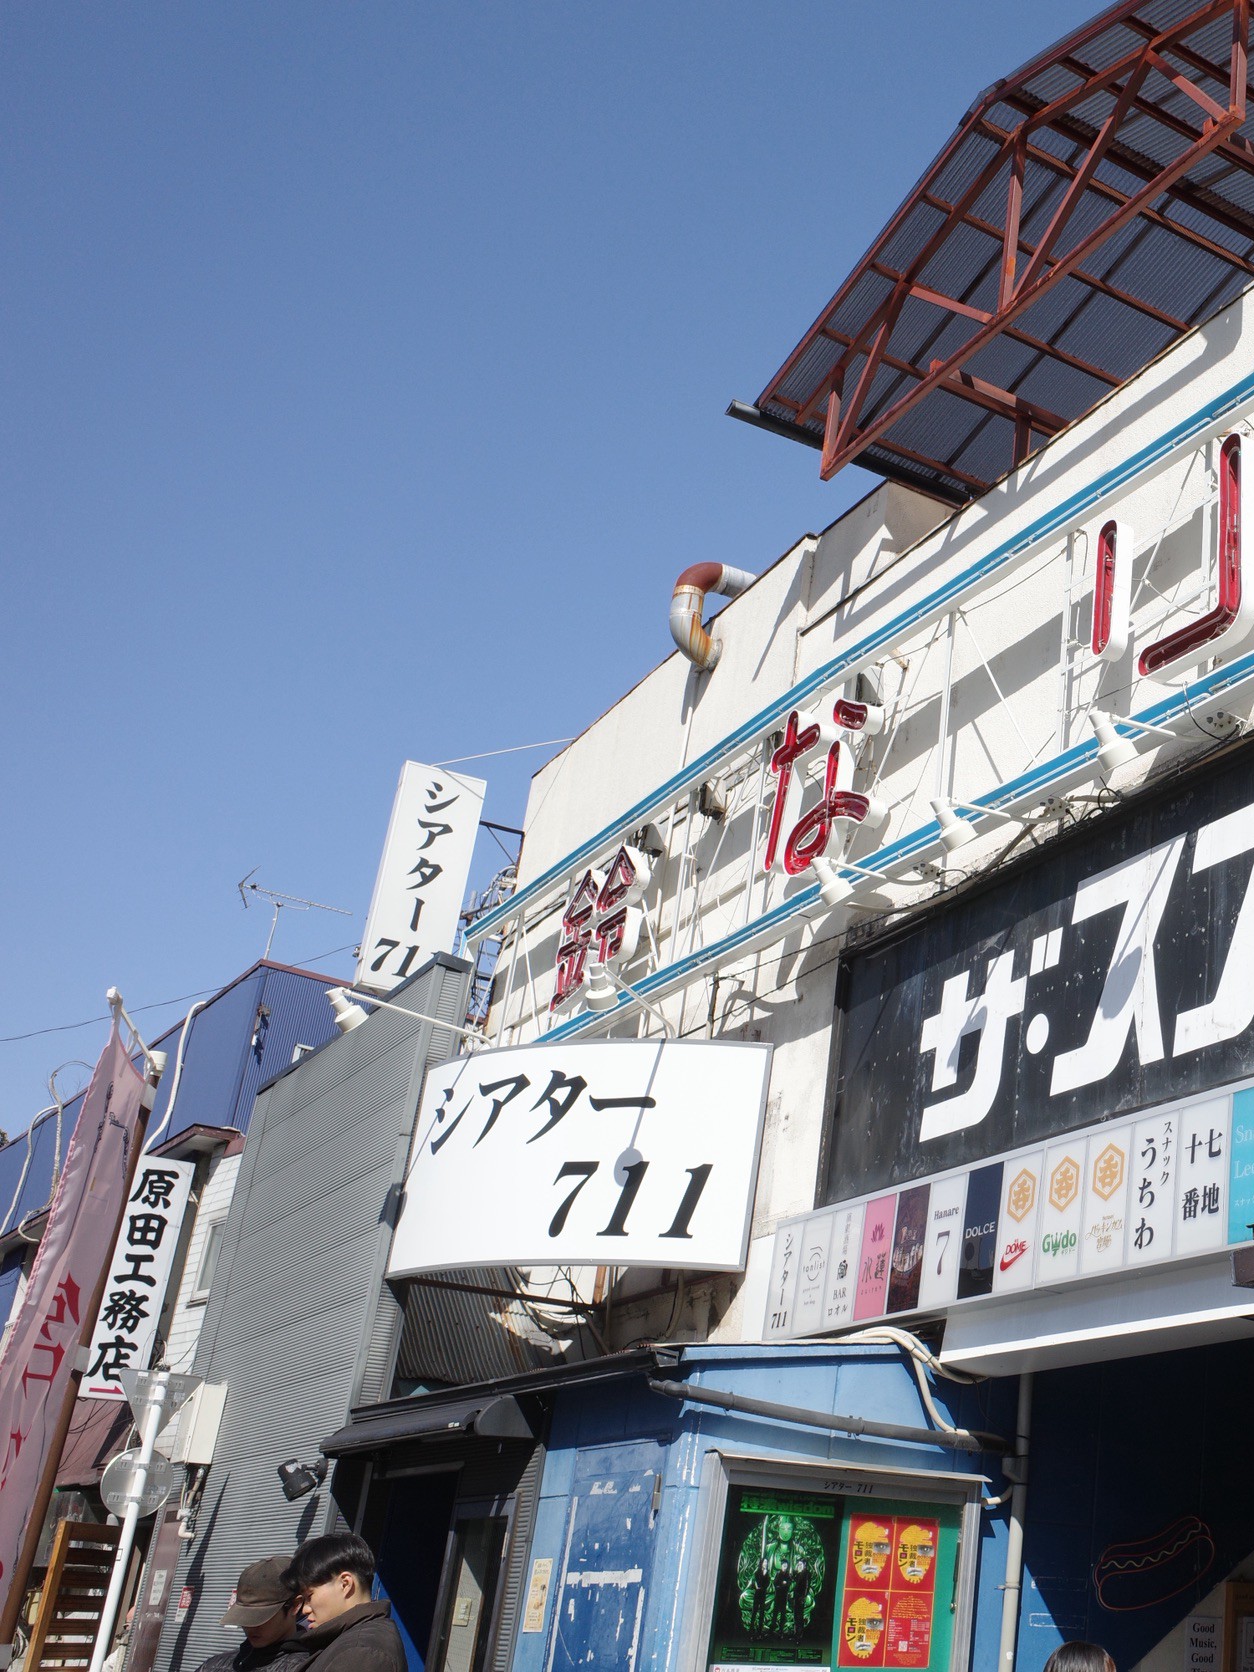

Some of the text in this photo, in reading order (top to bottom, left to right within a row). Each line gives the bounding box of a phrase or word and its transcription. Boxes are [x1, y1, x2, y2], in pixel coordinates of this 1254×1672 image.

[370, 781, 460, 978] シアター71
[430, 1070, 656, 1155] シアター
[1160, 1121, 1173, 1186] スナック
[549, 1161, 714, 1239] 711
[1134, 1137, 1157, 1249] うちわ
[934, 1206, 960, 1220] Hanare
[965, 1222, 996, 1239] DOLCE
[936, 1230, 951, 1275] 7
[84, 1168, 180, 1382] 原田工務店
[833, 1288, 847, 1301] BAR
[824, 1481, 874, 1494] シアター 711
[1189, 1638, 1217, 1650] Music,
[1192, 1623, 1215, 1634] Good
[1191, 1653, 1214, 1663] Good
